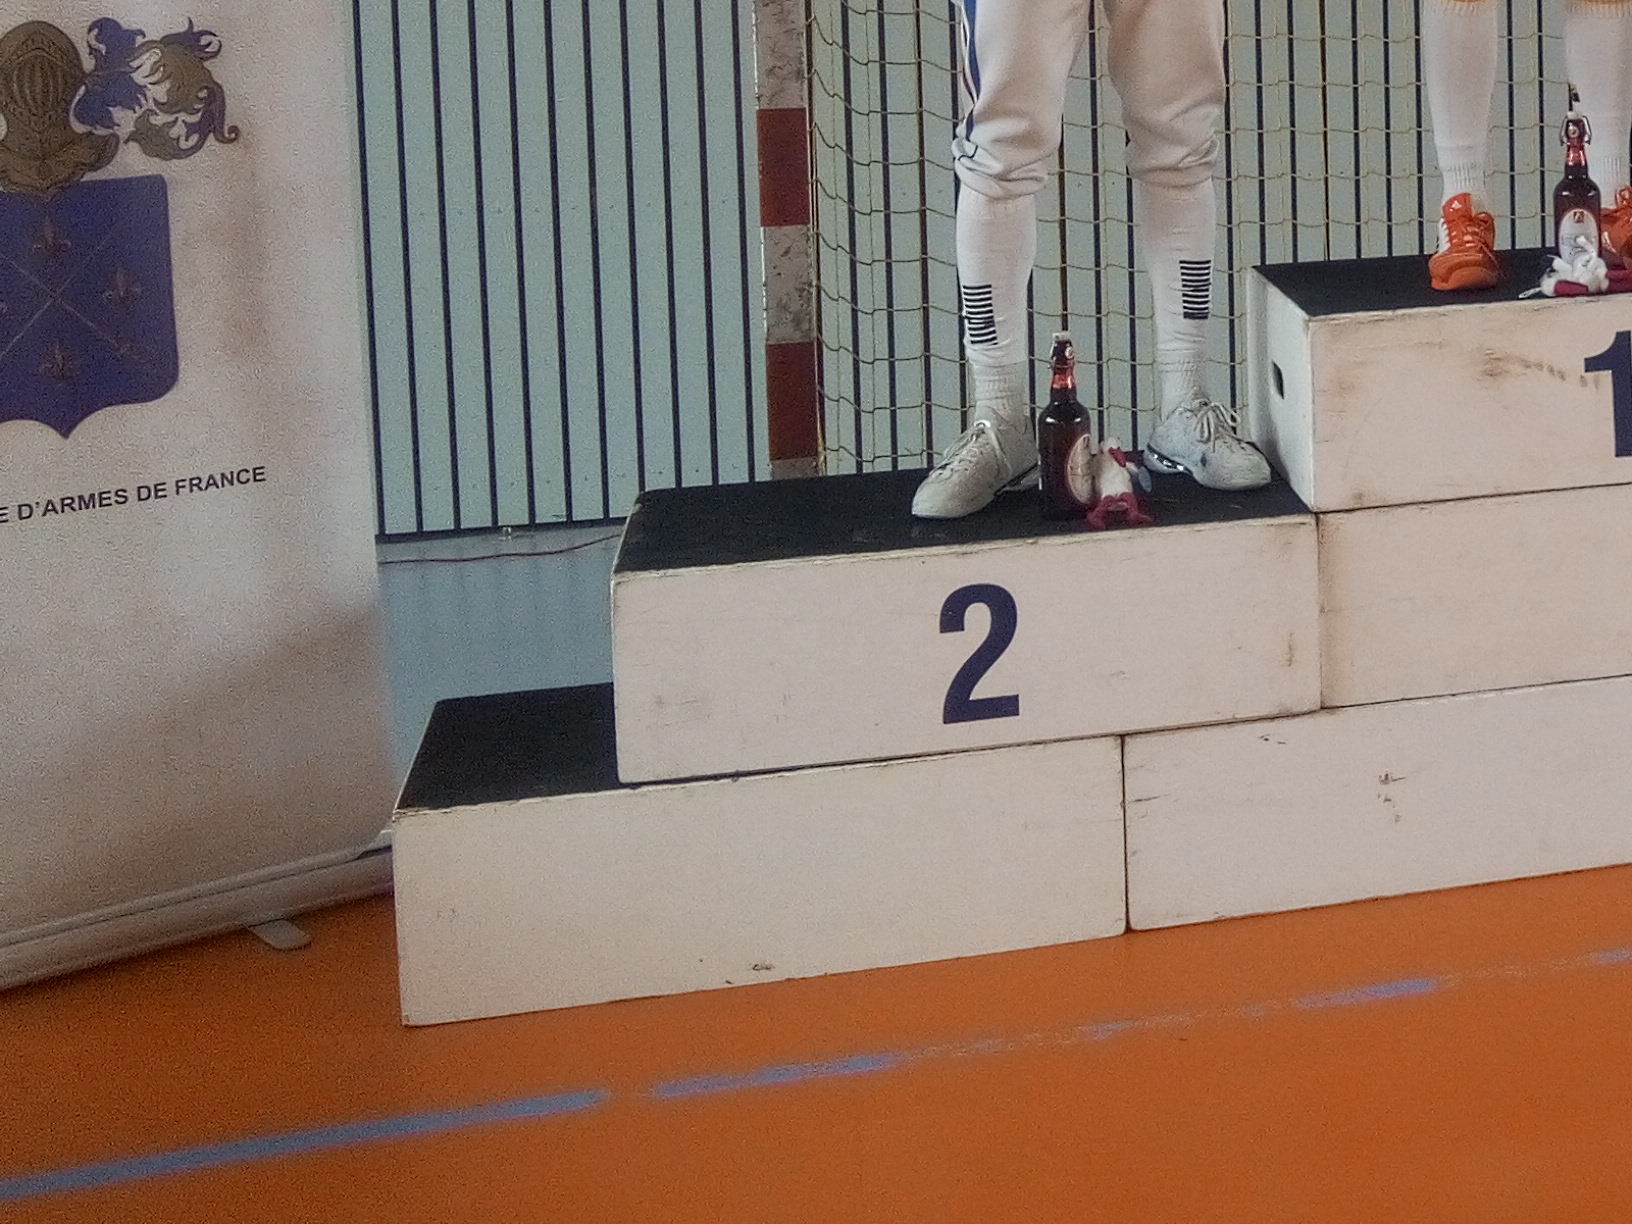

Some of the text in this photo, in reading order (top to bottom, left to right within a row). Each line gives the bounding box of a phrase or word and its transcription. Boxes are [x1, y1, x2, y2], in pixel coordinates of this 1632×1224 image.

[17, 488, 128, 521] D'ARMES
[137, 482, 168, 503] DE
[175, 466, 267, 495] FRANCE
[939, 583, 1020, 725] 2
